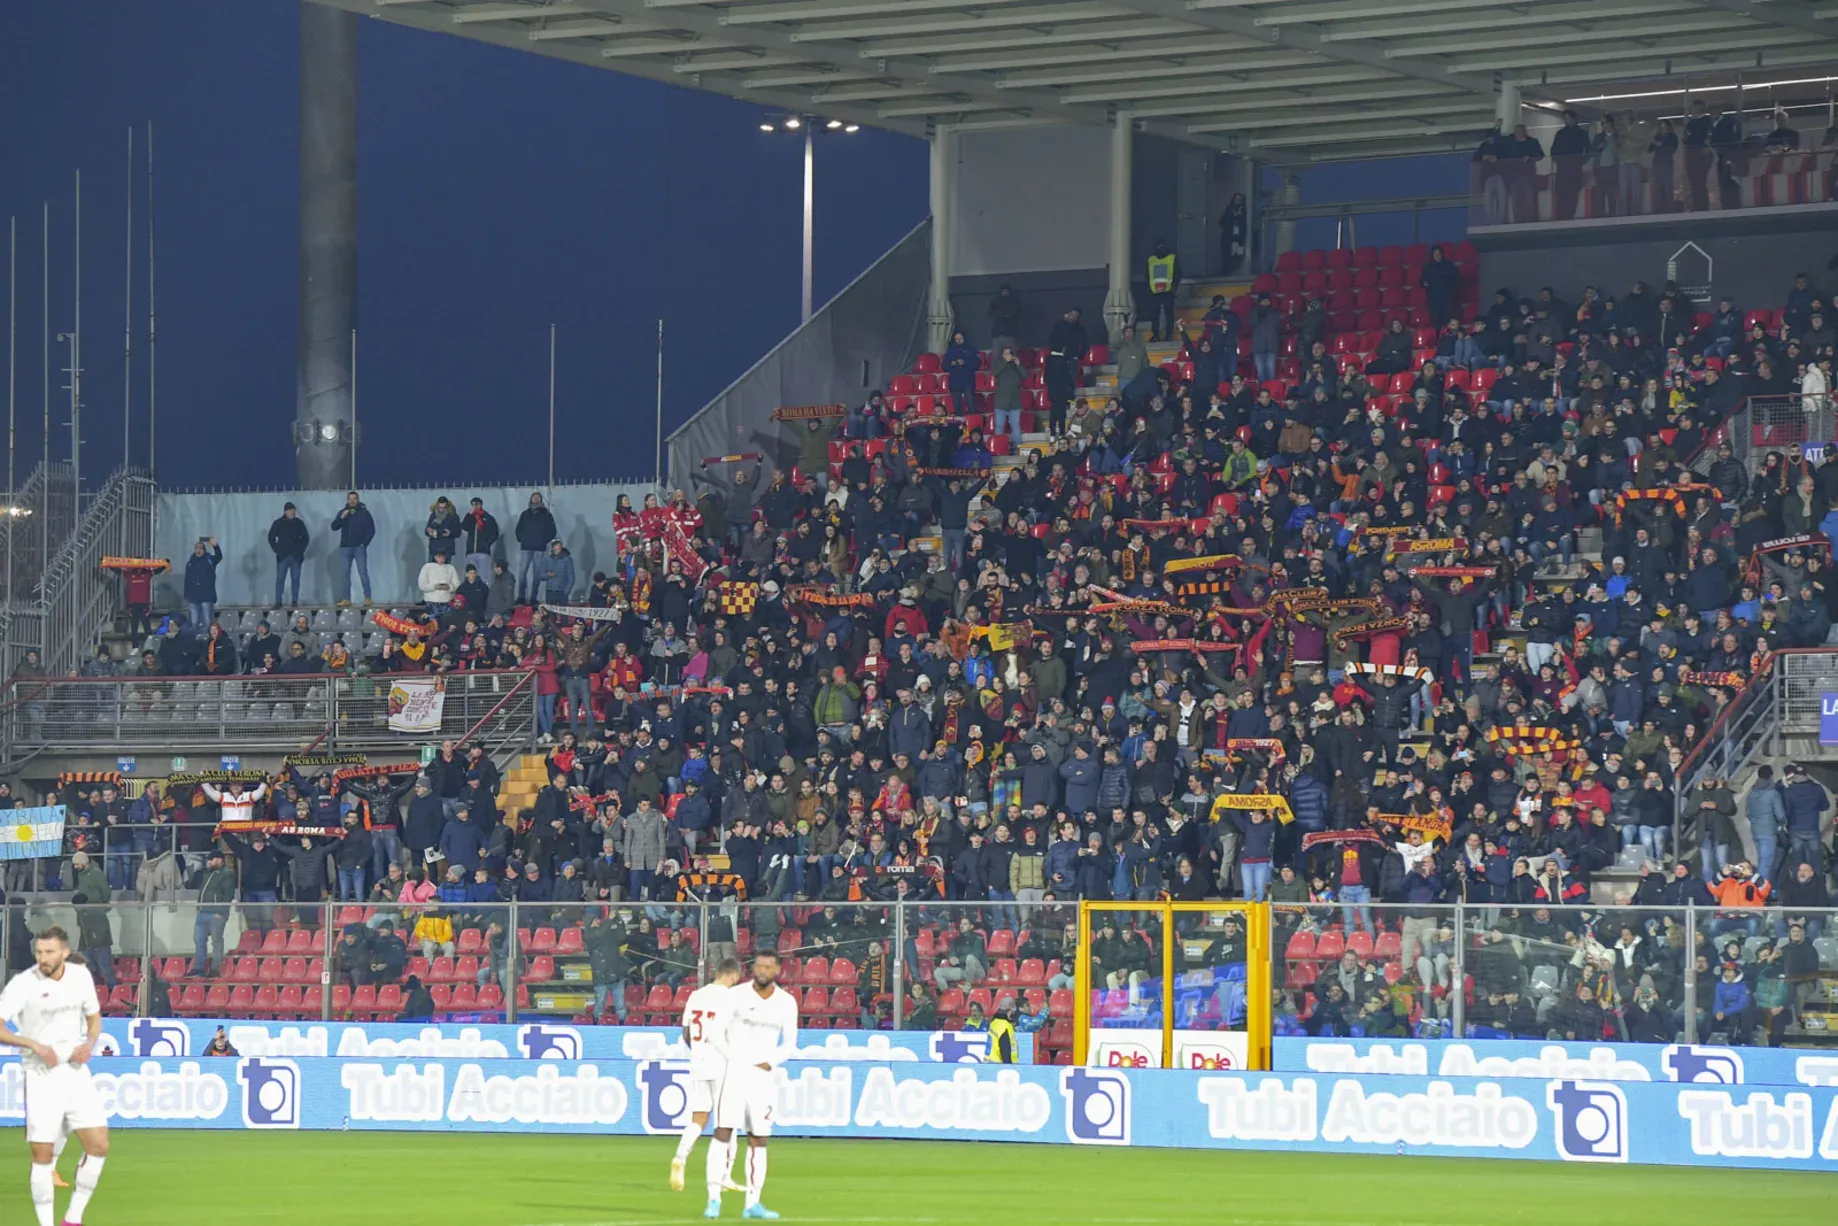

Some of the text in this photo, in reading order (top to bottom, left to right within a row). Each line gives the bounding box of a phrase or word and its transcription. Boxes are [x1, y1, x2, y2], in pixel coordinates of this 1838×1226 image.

[0, 806, 60, 826] YBALA
[297, 826, 326, 834] ROMA
[887, 865, 915, 873] roma
[1108, 1051, 1148, 1068] Dole
[1192, 1052, 1231, 1070] Dole
[94, 1064, 224, 1116] cciaio
[344, 1067, 440, 1117] Tubi
[449, 1067, 625, 1121] Acciaio
[776, 1069, 849, 1122] ubi
[860, 1071, 1047, 1126] Acciaio
[1202, 1081, 1312, 1136] Tubi
[1326, 1084, 1532, 1143] Acciaio
[1683, 1095, 1809, 1153] Tubi
